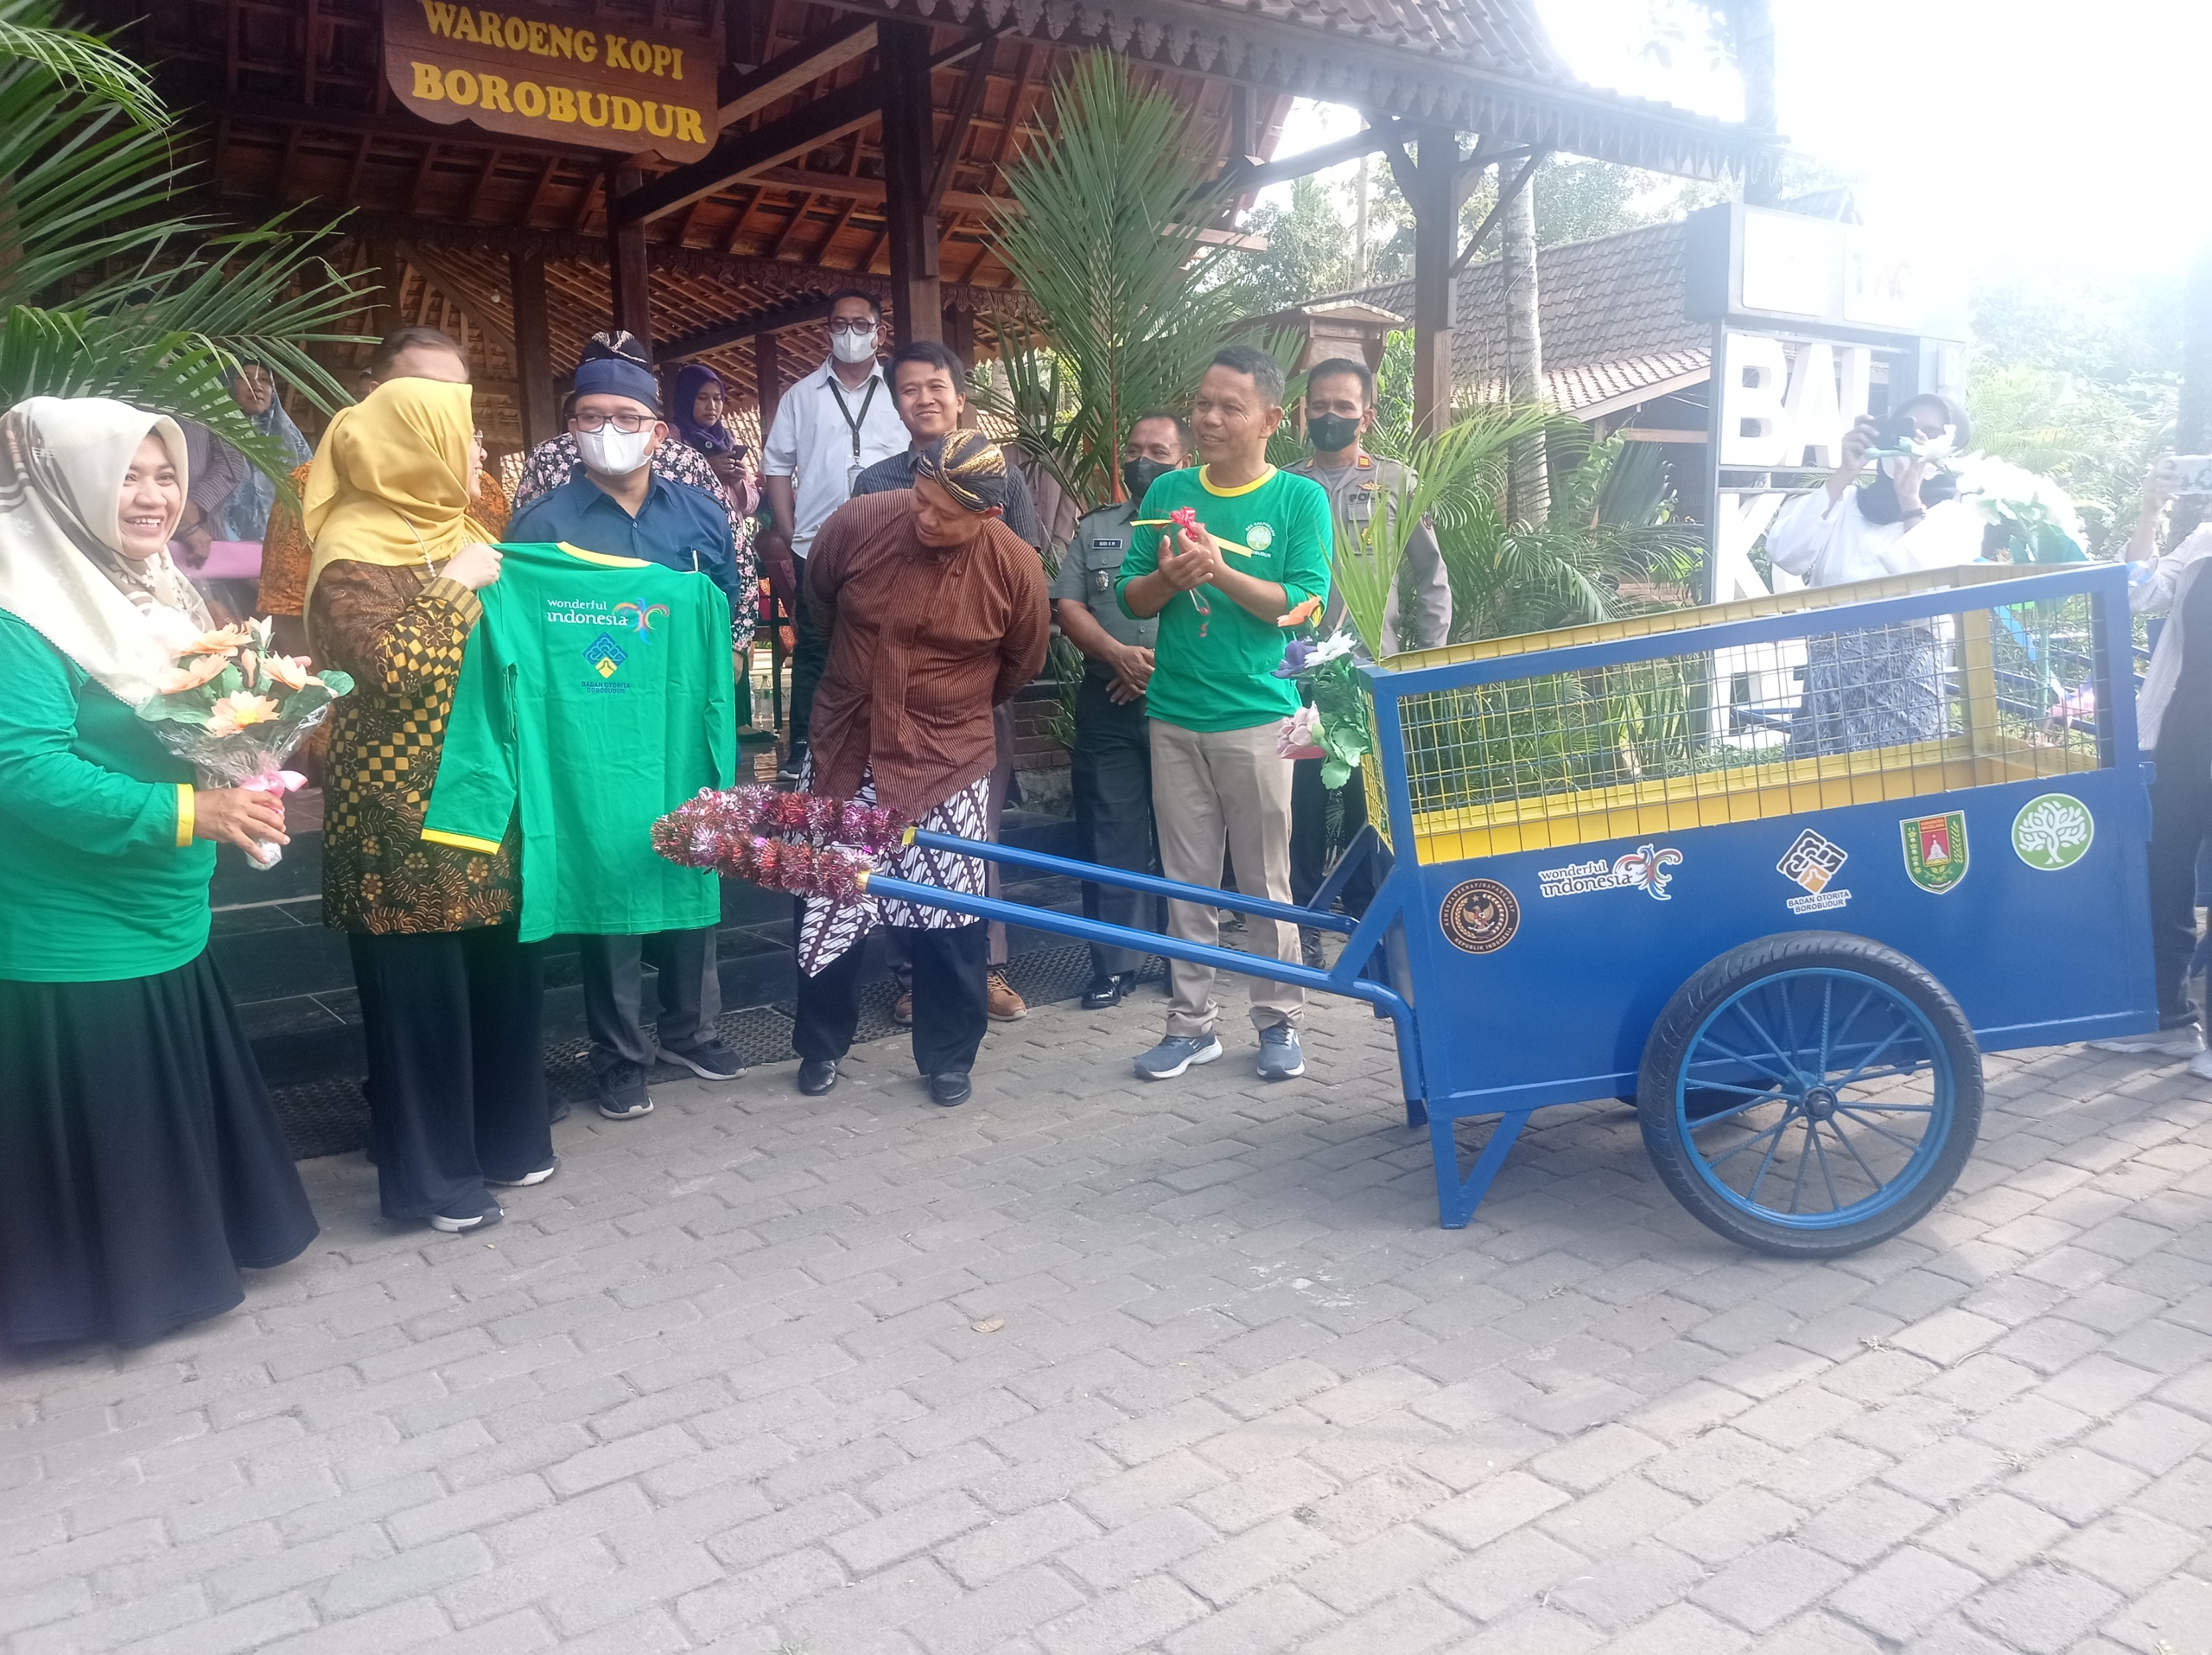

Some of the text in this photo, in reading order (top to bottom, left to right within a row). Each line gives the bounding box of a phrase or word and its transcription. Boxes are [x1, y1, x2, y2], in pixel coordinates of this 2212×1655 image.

[421, 0, 683, 80] WAROENG KOPI
[411, 61, 706, 143] BOROBUDUR
[546, 598, 607, 610] wonderful
[546, 609, 629, 626] indonesia
[1541, 862, 1607, 880] wonderful
[1542, 872, 1633, 896] indonesia
[1788, 891, 1850, 907] BADAN OTORITA
[1795, 899, 1844, 913] BOROBUDUR
[1454, 927, 1513, 951] REPUBLIK INDONESIA
